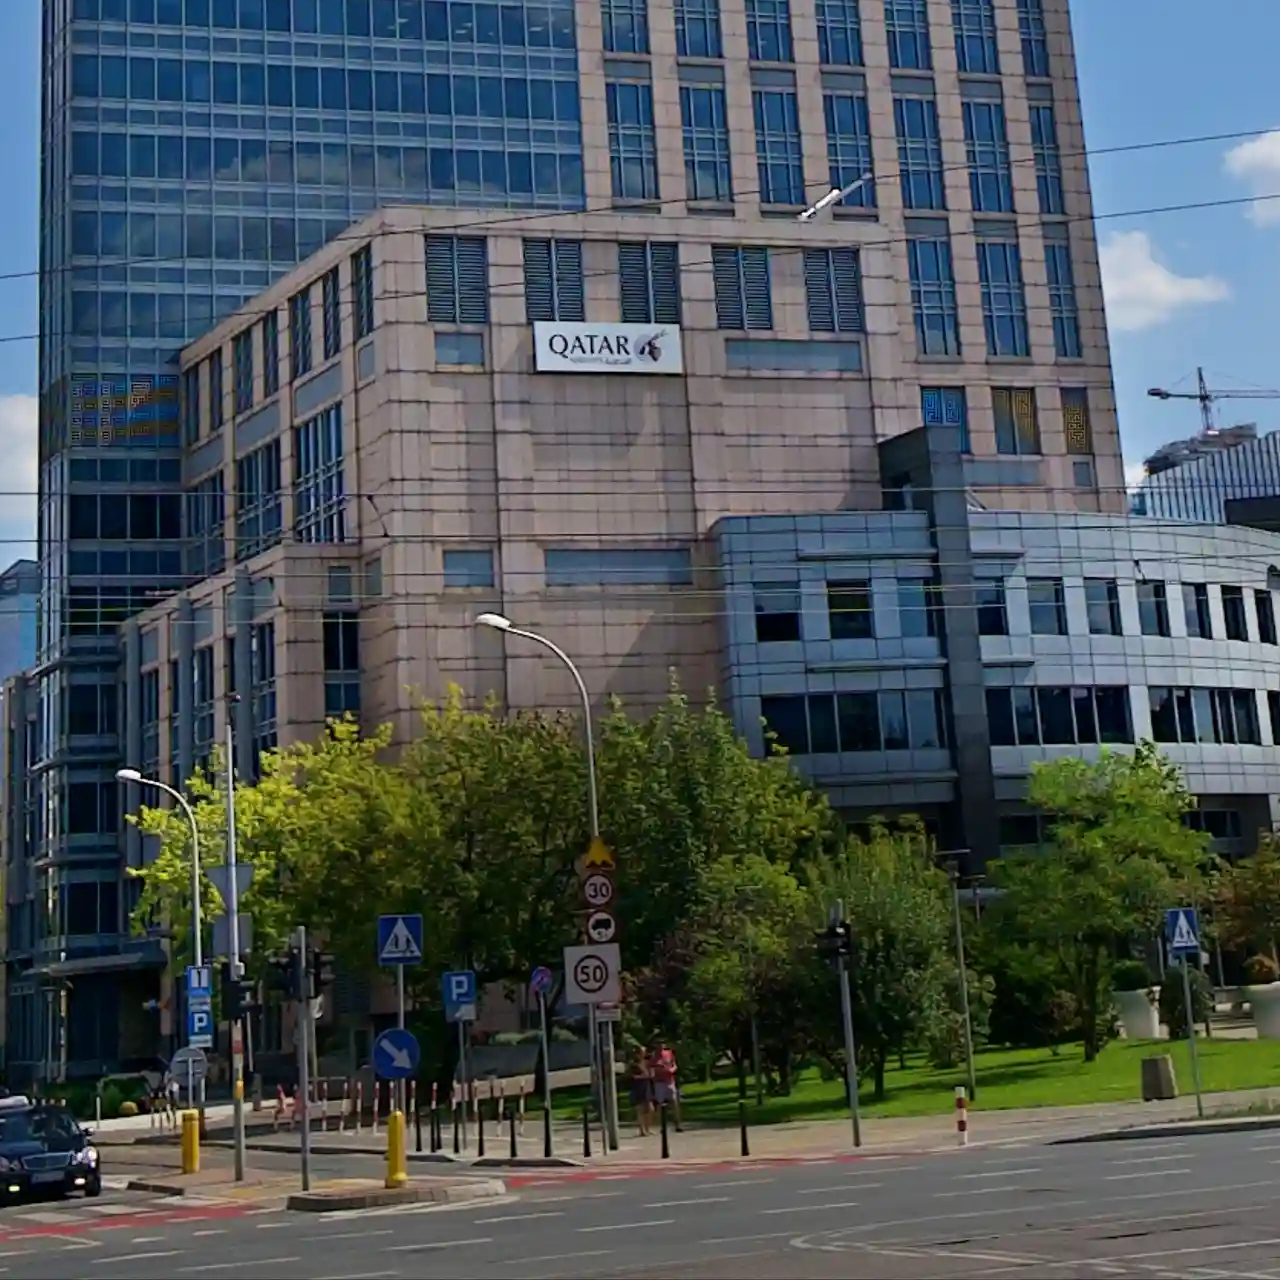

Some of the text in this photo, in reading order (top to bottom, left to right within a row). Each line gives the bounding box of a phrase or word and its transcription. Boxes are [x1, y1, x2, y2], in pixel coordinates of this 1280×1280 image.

[549, 334, 630, 359] QATAR
[588, 883, 610, 899] 30
[580, 965, 604, 984] 50
[451, 976, 469, 1001] P
[193, 1013, 208, 1033] P
